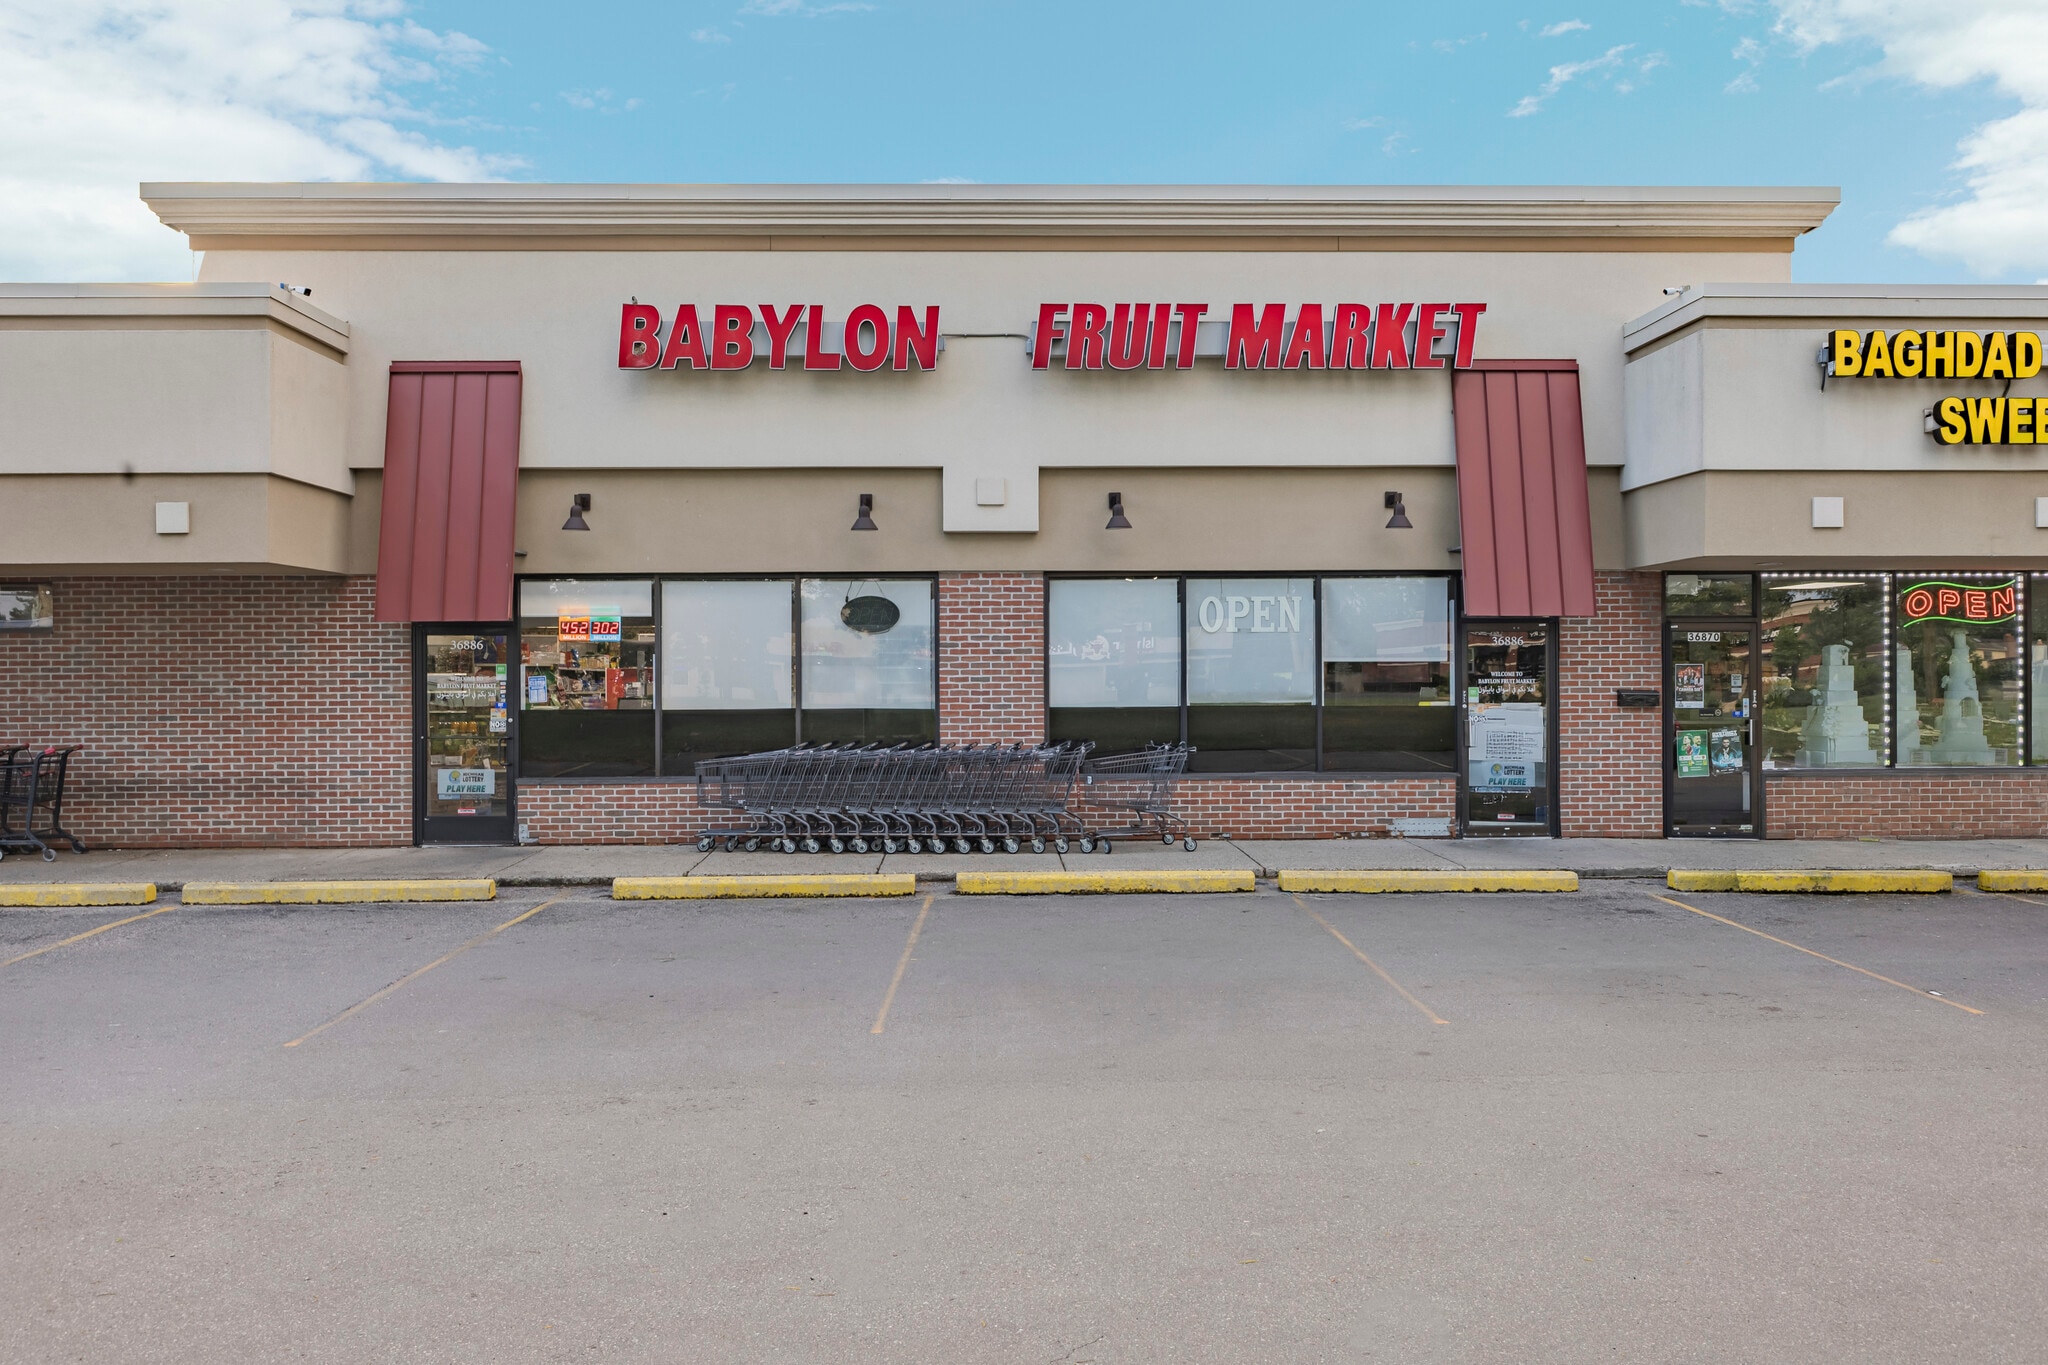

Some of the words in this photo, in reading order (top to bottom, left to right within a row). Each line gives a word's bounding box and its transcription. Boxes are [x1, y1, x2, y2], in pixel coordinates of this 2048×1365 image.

[618, 303, 940, 371] BABYLON
[1031, 303, 1209, 370] FRUIT
[1224, 303, 1488, 370] MARKET
[1830, 329, 2043, 379] BAGHDAD
[1905, 587, 2016, 618] OPEN
[1199, 596, 1302, 633] OPEN
[561, 621, 589, 634] 452
[592, 621, 619, 634] 302
[1491, 636, 1524, 646] 36886
[1688, 632, 1720, 641] 36870
[450, 640, 484, 650] 36886
[1488, 778, 1507, 786] PLAY
[1507, 778, 1527, 786] HERE
[446, 785, 466, 793] PLAY
[466, 785, 486, 793] HERE
